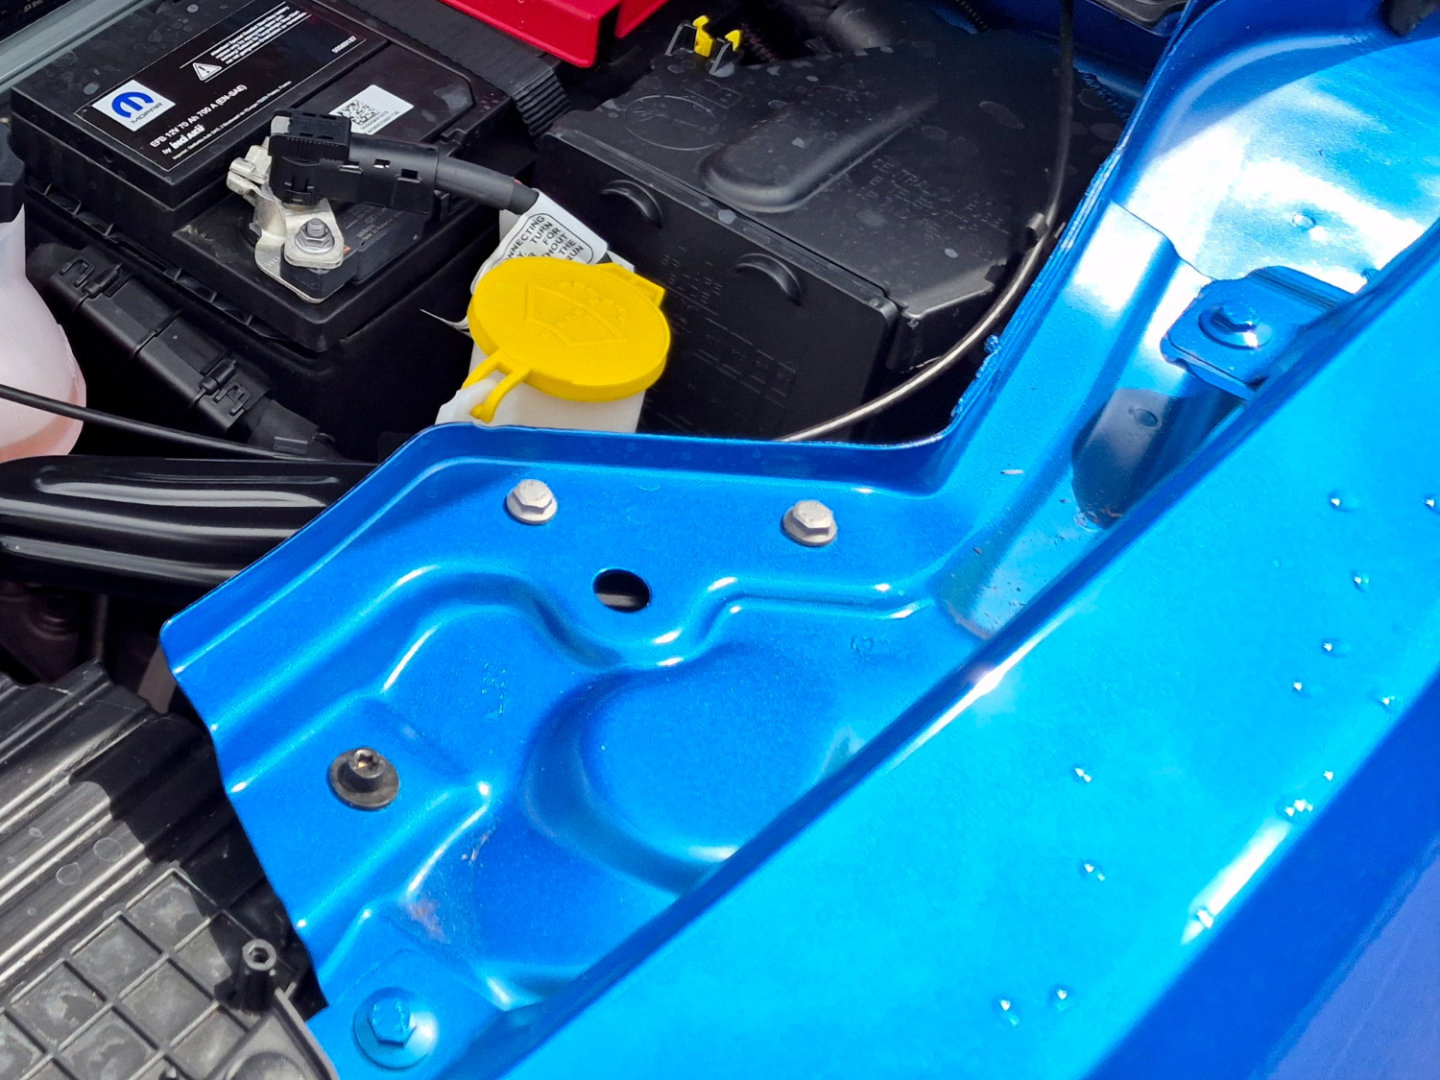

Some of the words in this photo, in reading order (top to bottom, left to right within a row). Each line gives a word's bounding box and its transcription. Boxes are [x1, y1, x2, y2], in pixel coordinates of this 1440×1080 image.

[530, 221, 553, 244] TURN
[542, 227, 562, 246] FOR
[558, 239, 576, 255] THE
